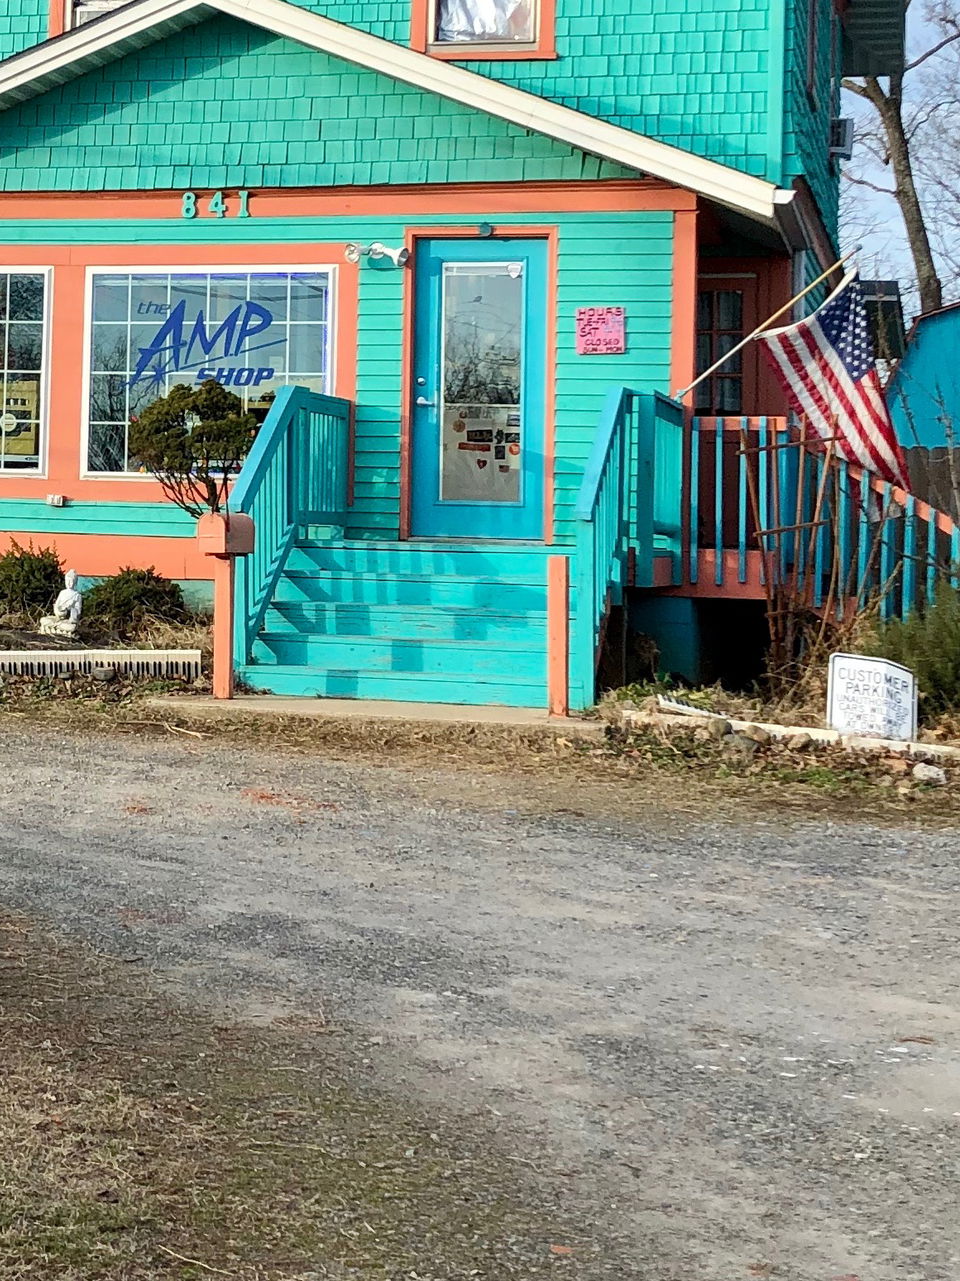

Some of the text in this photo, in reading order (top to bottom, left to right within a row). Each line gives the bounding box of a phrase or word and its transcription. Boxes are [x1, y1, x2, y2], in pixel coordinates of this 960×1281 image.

[182, 190, 249, 219] 841
[137, 301, 171, 315] the
[579, 307, 622, 317] HOURS
[580, 326, 600, 337] SAT
[121, 299, 274, 390] AMP
[585, 338, 620, 346] CLOSED
[195, 367, 275, 386] SHOP
[838, 668, 909, 694] CUSTOMER
[846, 681, 902, 704] PARKING
[839, 702, 865, 712] CARS
